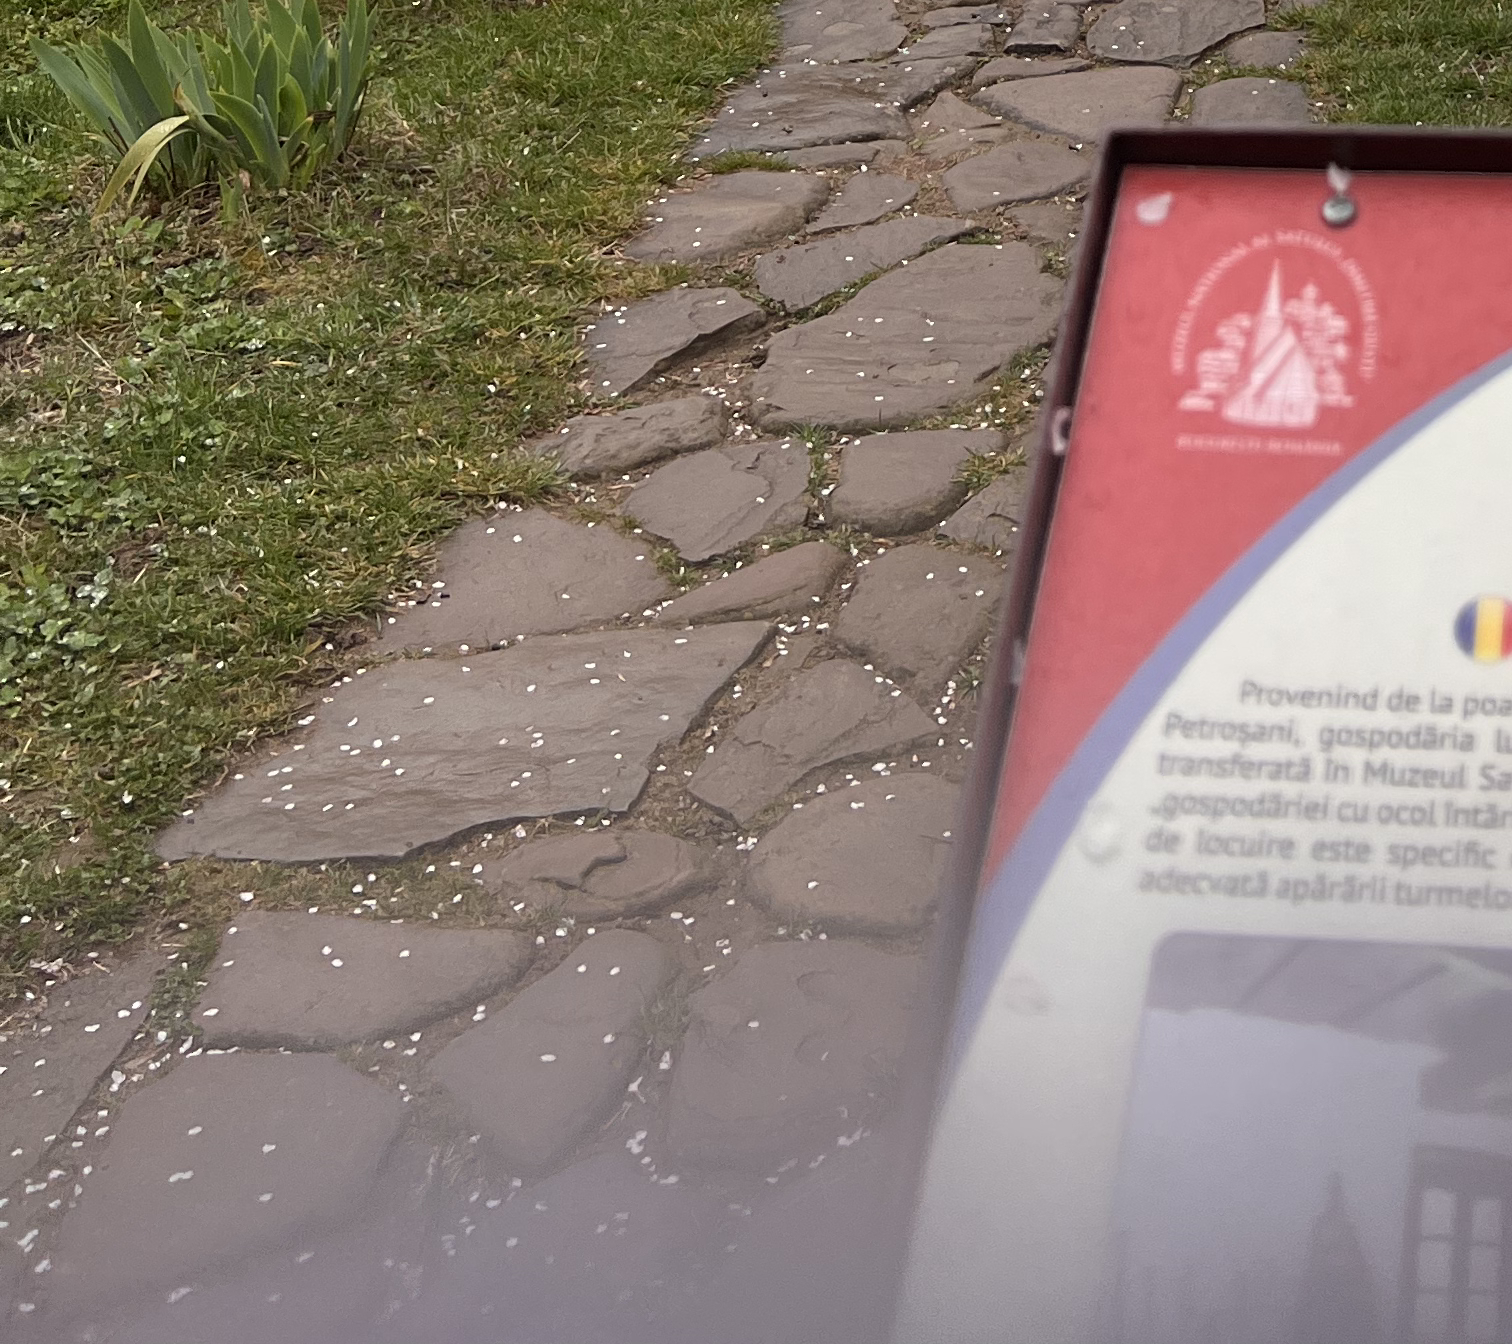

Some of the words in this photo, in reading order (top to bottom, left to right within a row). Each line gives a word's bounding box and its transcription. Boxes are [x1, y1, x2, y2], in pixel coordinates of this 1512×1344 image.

[1239, 678, 1379, 712] Provenind
[1386, 684, 1421, 713] de
[1429, 685, 1455, 714] la
[1323, 757, 1353, 786] în
[1362, 759, 1467, 791] Muzeul
[1337, 801, 1371, 825] cu
[1377, 800, 1437, 828] ocol
[1144, 825, 1182, 855] de
[1197, 829, 1296, 861] locuire
[1310, 837, 1372, 864] este
[1387, 839, 1499, 871] specific
